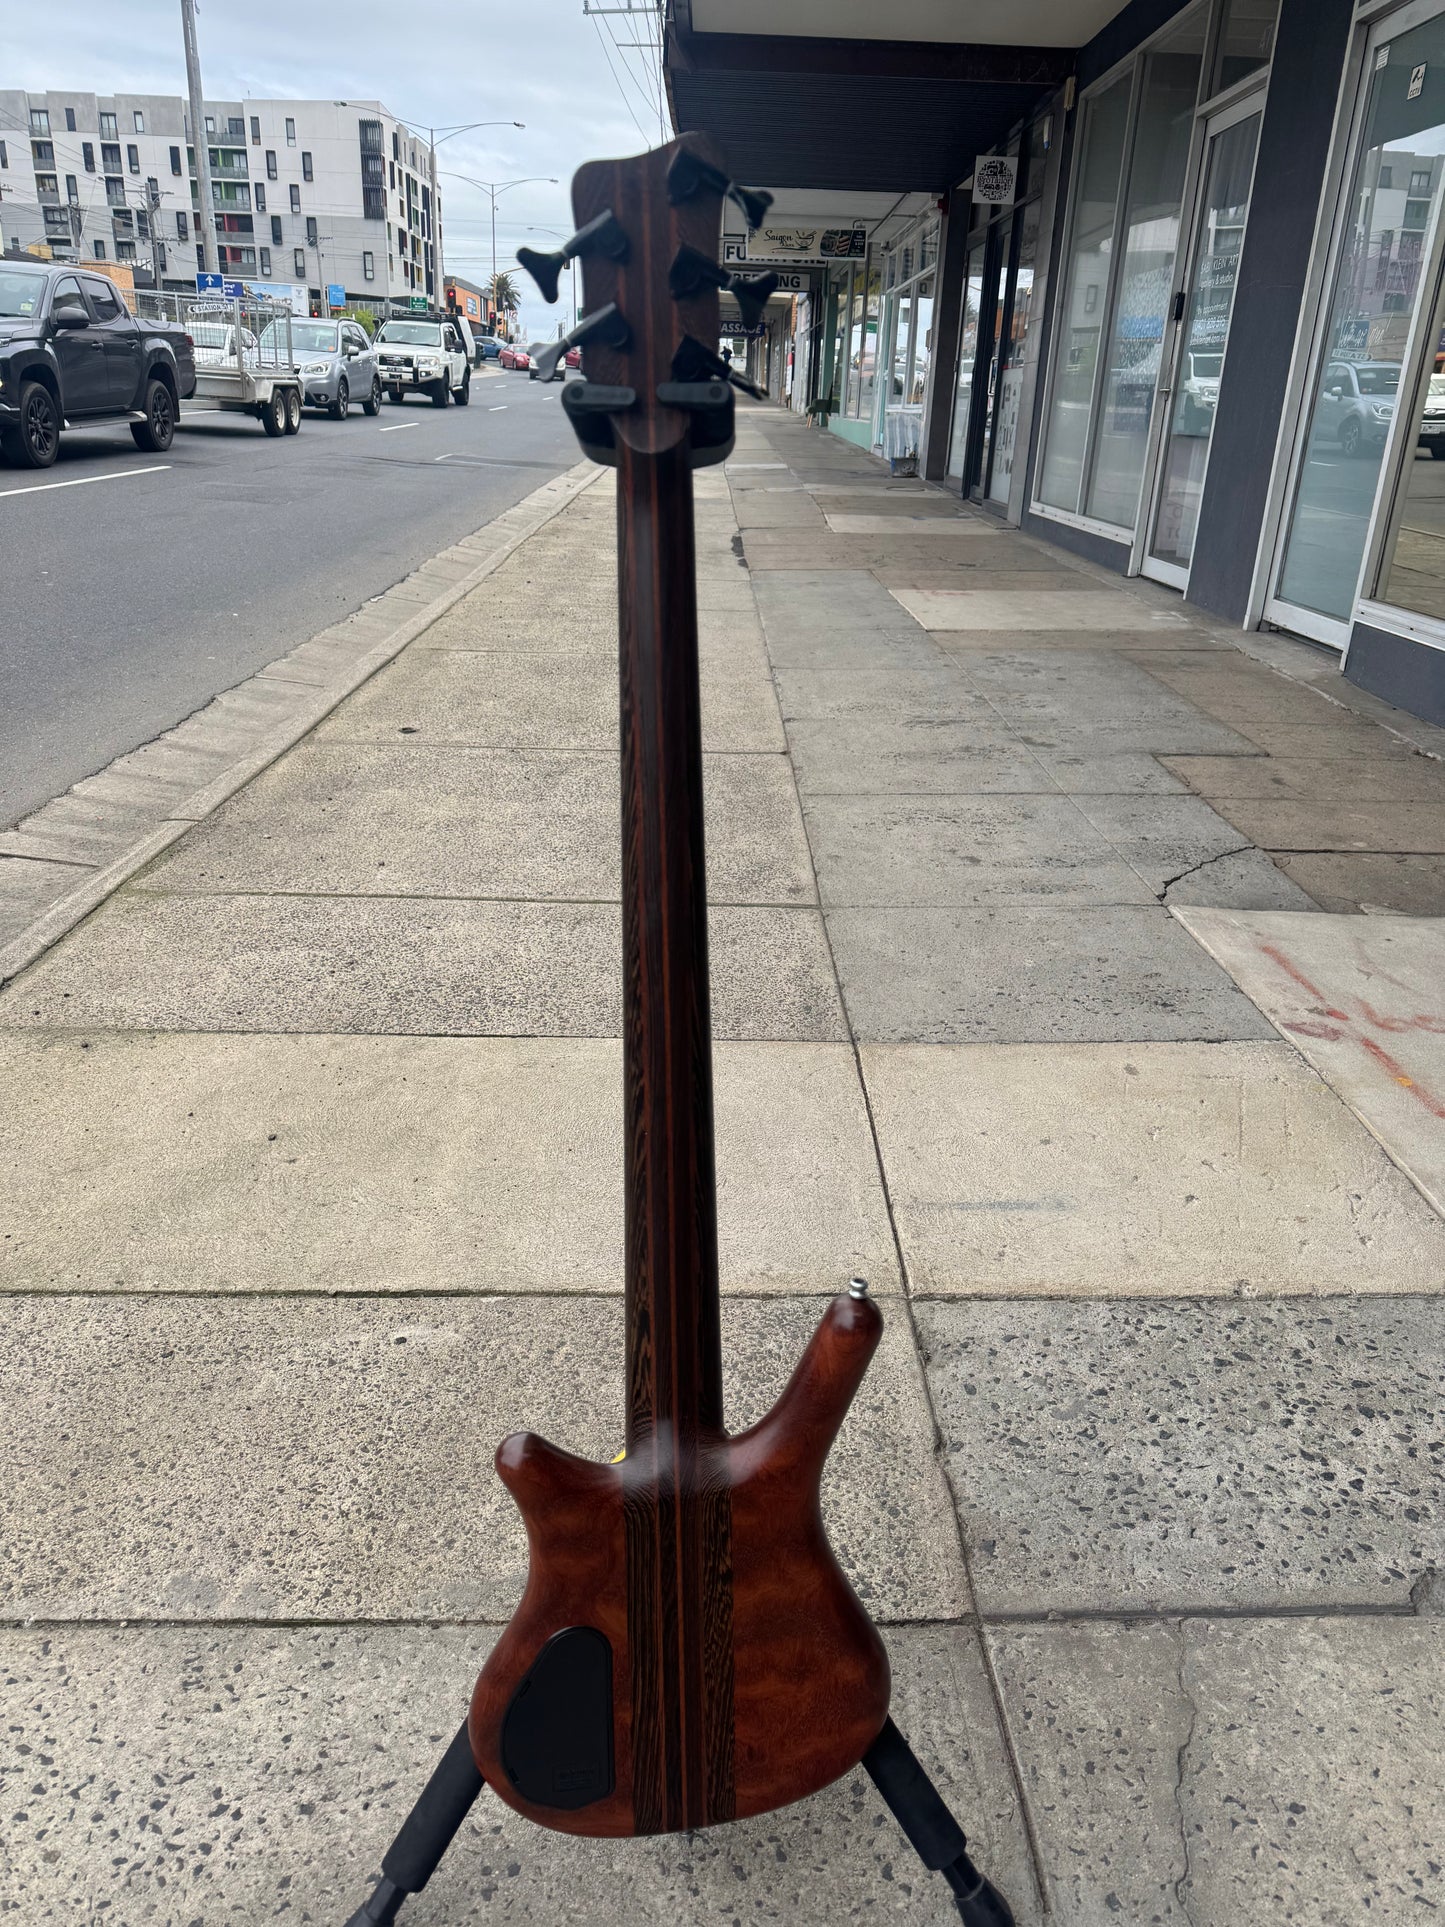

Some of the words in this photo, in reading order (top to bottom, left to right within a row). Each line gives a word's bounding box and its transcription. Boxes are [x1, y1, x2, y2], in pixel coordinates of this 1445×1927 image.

[763, 229, 793, 243] Saigon
[197, 303, 221, 312] STATION
[720, 322, 762, 334] ASSAE
